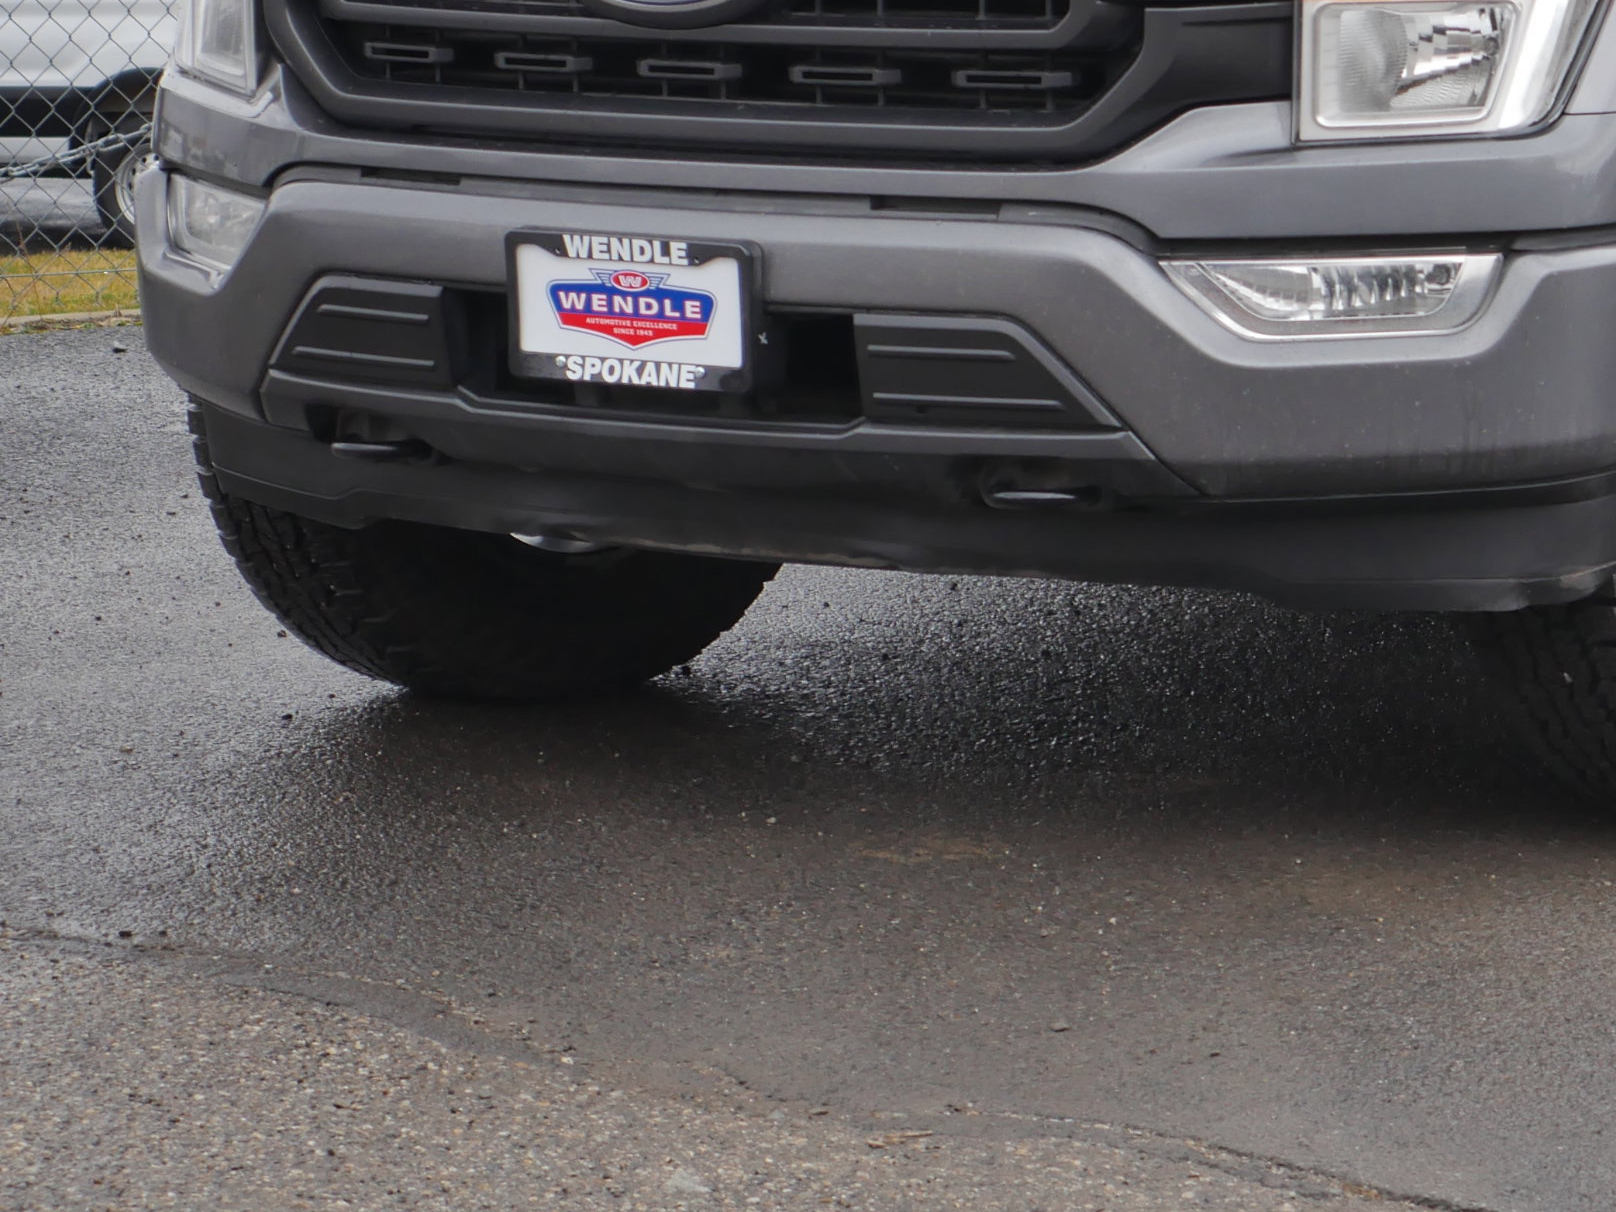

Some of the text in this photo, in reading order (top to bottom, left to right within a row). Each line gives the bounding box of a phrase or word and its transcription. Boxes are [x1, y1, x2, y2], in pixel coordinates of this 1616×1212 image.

[562, 234, 689, 266] WENDLE
[557, 291, 702, 319] WENDLE
[585, 317, 678, 330] AUTOMOTIVE EXCELLENCE
[612, 327, 635, 335] SINCE
[564, 355, 697, 389] SPOKANE
